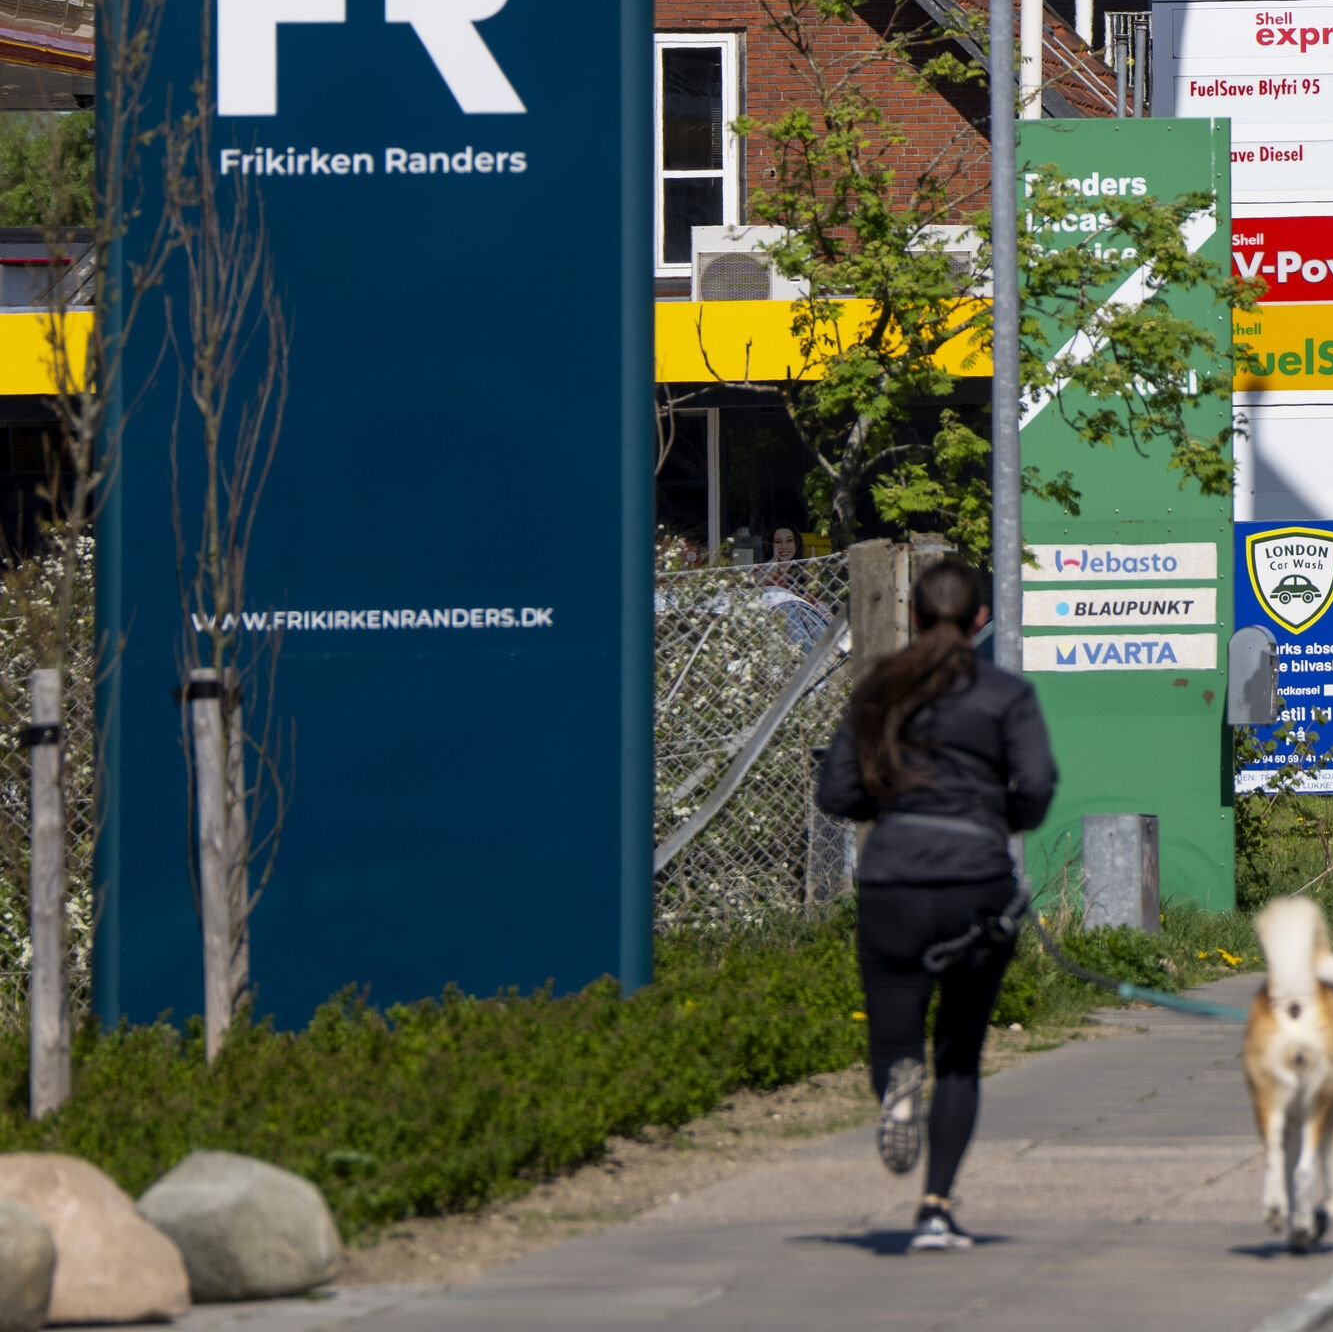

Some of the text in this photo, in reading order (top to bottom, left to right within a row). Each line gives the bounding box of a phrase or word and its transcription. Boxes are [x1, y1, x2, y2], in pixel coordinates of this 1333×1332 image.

[1256, 12, 1292, 25] Shell
[1190, 79, 1321, 100] FuelSave Blyfri 95
[220, 146, 527, 175] Frikirken Randers
[1260, 144, 1303, 162] Diesel
[1232, 233, 1264, 246] Shell
[1265, 544, 1329, 559] LONDON
[1055, 550, 1177, 573] Webasto
[1269, 559, 1323, 571] Car Wash
[1074, 601, 1194, 616] BLAUPUNKT
[1082, 641, 1177, 665] VARTA
[1277, 685, 1320, 696] ndkørsel
[1262, 755, 1273, 763] 94
[1275, 755, 1286, 763] 60
[1306, 754, 1316, 763] 41
